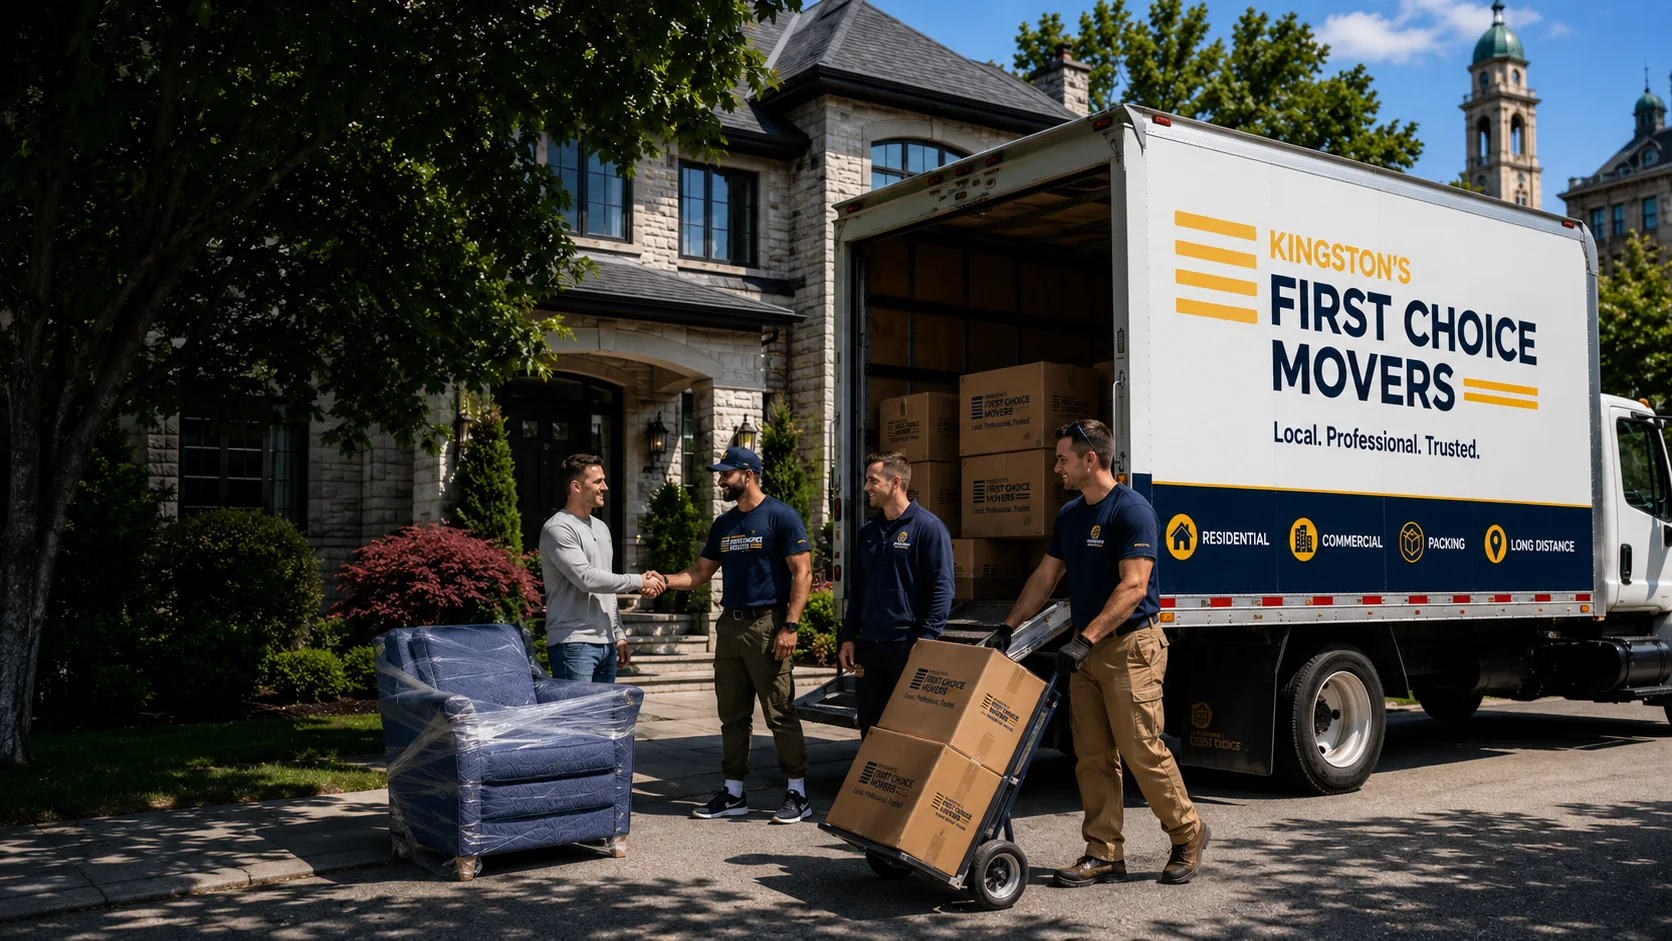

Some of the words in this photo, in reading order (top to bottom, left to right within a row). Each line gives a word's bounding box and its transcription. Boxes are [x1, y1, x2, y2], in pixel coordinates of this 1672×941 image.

[1269, 229, 1412, 285] KINGSTON'S
[1270, 273, 1392, 342] FIRST
[1403, 299, 1538, 366] CHOICE
[1272, 339, 1456, 412] MOVERS
[1273, 420, 1322, 447] Local.
[1326, 425, 1422, 455] Professional.
[1425, 434, 1480, 460] Trusted.
[1202, 530, 1270, 546] RESIDENTIAL
[1322, 533, 1384, 549] COMMERCIAL
[1428, 536, 1466, 551] PACKING
[1510, 538, 1534, 552] LONG
[1535, 539, 1575, 553] DISTANCE
